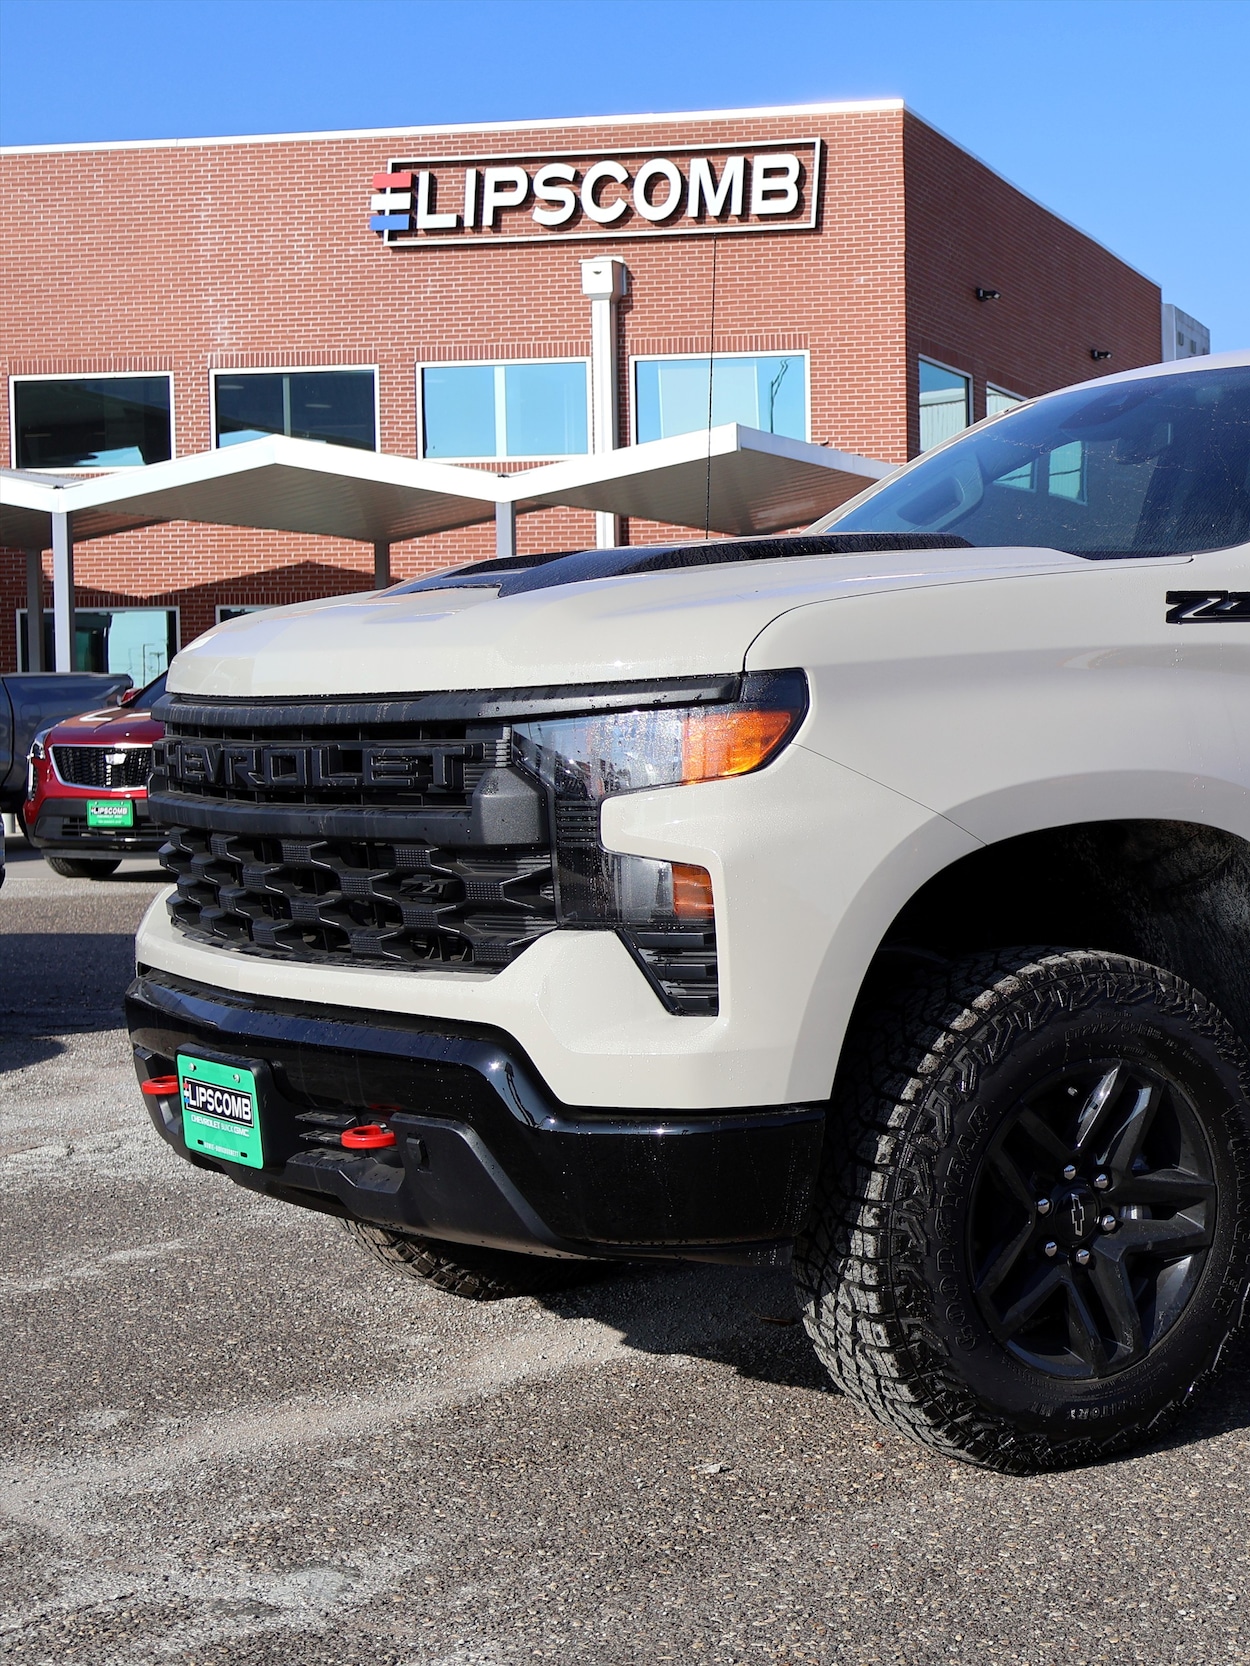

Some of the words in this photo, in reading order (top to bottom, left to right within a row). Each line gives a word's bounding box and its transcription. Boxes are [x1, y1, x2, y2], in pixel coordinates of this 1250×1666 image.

[415, 152, 802, 230] LIPSCOMB
[152, 740, 484, 790] CHEVROLET
[93, 807, 128, 815] LIPSCOMB
[188, 1083, 252, 1122] LIPSCOMB
[190, 1114, 220, 1130] CHEVROLET
[220, 1122, 234, 1133] BUICK
[233, 1126, 250, 1137] GMC
[934, 1103, 990, 1352] GOODYEAR
